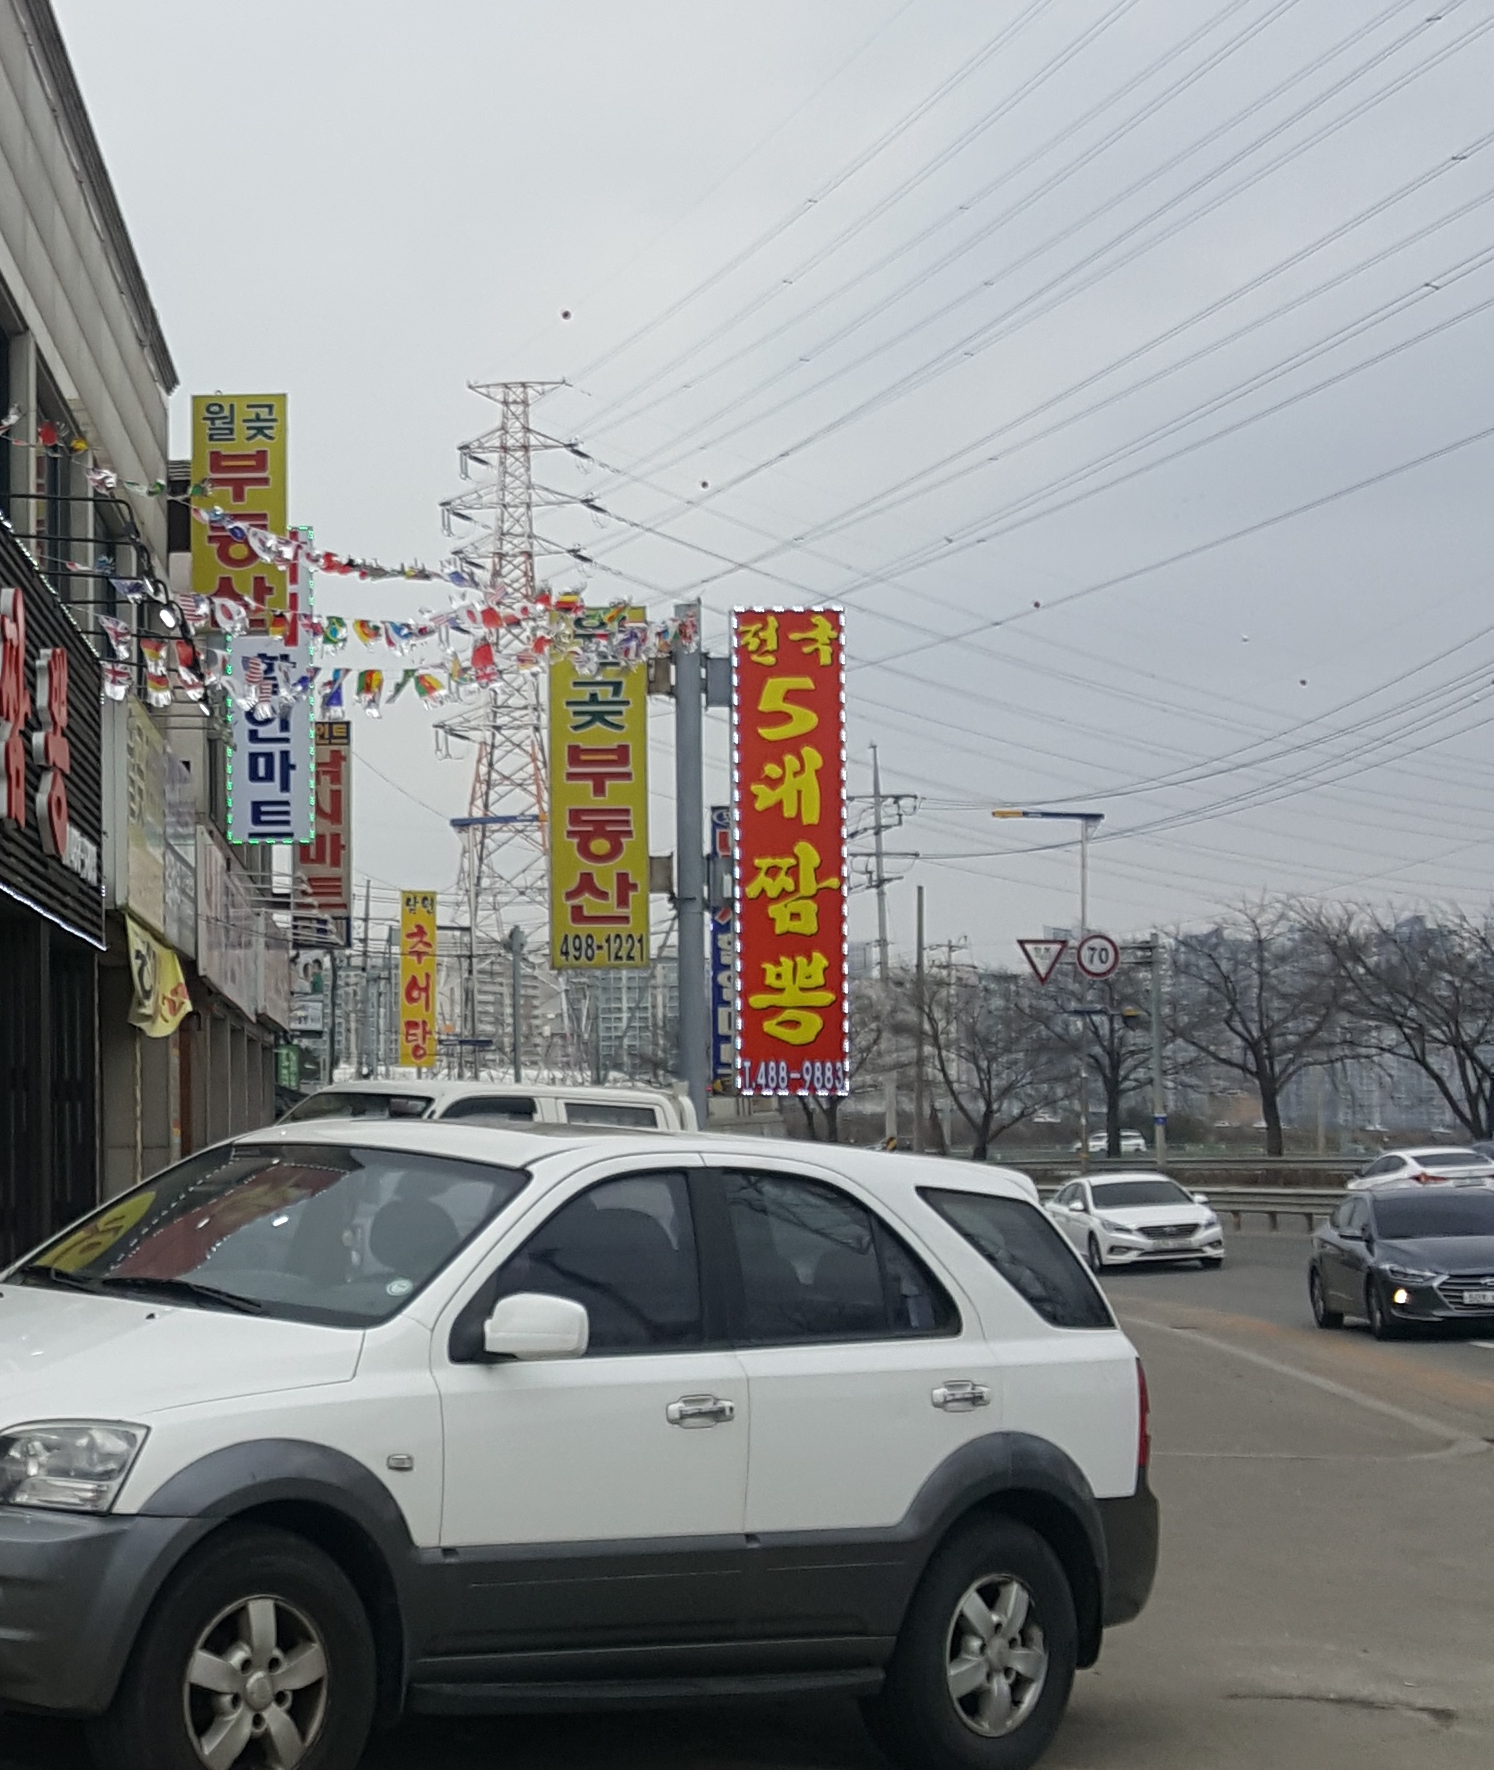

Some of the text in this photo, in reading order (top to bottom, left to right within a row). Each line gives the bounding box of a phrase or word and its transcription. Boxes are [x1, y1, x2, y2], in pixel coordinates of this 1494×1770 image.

[202, 402, 279, 442] 월곶
[739, 615, 838, 666] 전국
[564, 743, 639, 926] 부동산
[559, 933, 644, 962] 498-1221
[1087, 946, 1109, 965] 70
[404, 923, 433, 1062] 추어탕
[742, 1060, 845, 1089] T.488-9883
